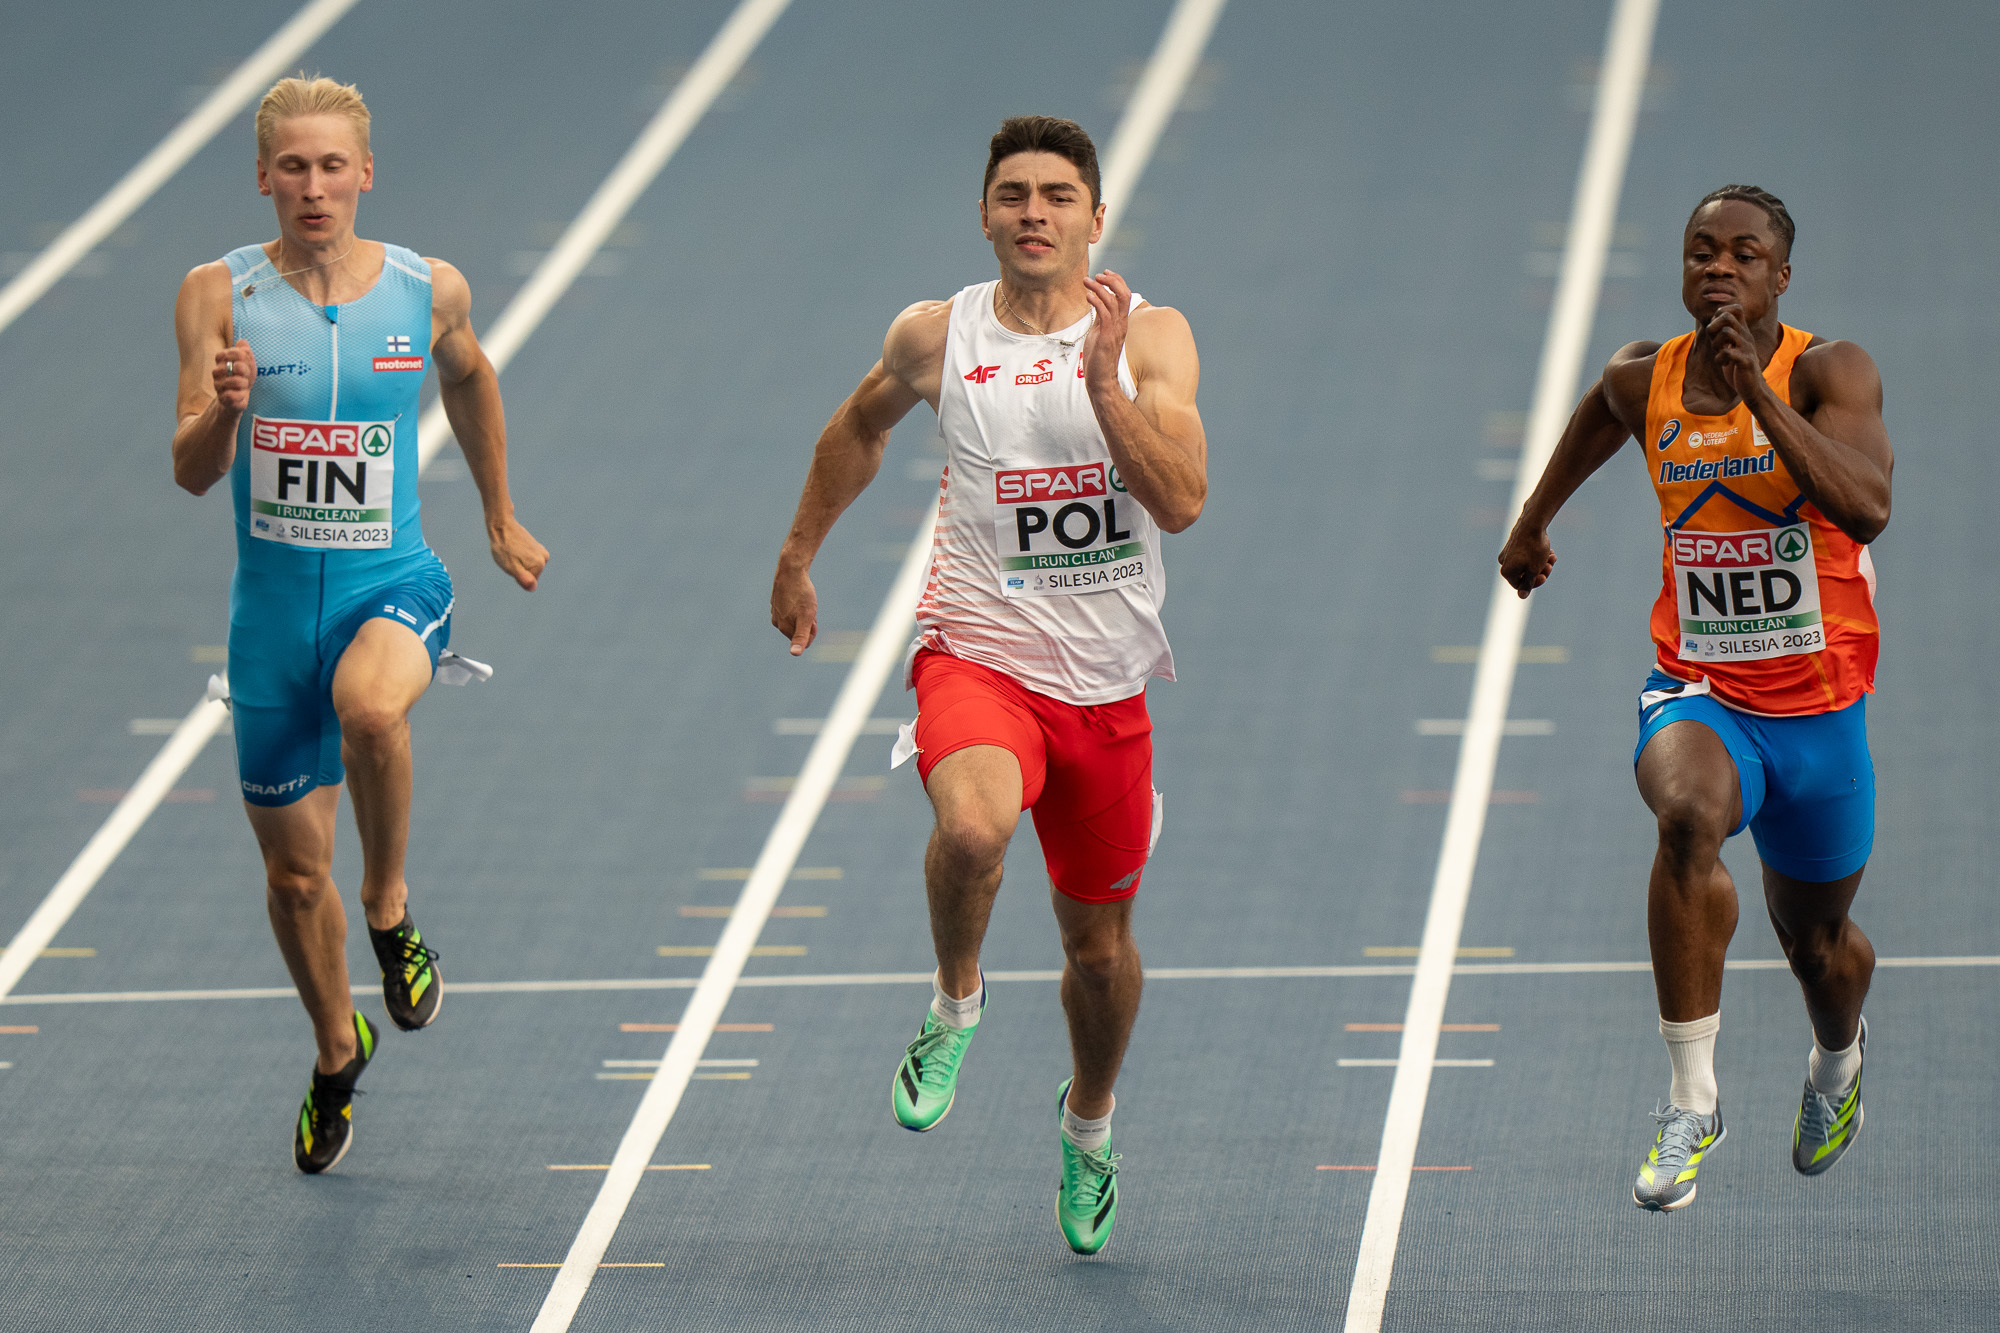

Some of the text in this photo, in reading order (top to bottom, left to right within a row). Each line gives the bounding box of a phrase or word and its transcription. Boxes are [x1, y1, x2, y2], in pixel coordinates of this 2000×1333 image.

[257, 364, 296, 377] RAFT
[374, 359, 423, 370] motonet
[963, 365, 1002, 384] 4F
[1016, 372, 1051, 384] ORLEN
[255, 425, 356, 453] SPAR
[277, 457, 367, 505] FIN
[998, 467, 1104, 499] SPAR
[283, 506, 313, 519] RUN
[290, 525, 389, 542] SILESIA 2023
[1015, 498, 1131, 552] POL
[1675, 537, 1770, 563] SPAR
[1031, 557, 1036, 568] I
[1038, 555, 1069, 567] RUN
[1048, 561, 1144, 588] SILESIA 2023
[1686, 568, 1802, 617] NED
[1702, 623, 1707, 633] I
[1709, 622, 1738, 633] RUN
[1719, 630, 1821, 654] SILESIA 2023
[242, 779, 298, 795] CRAFT
[1109, 863, 1144, 890] 4F
